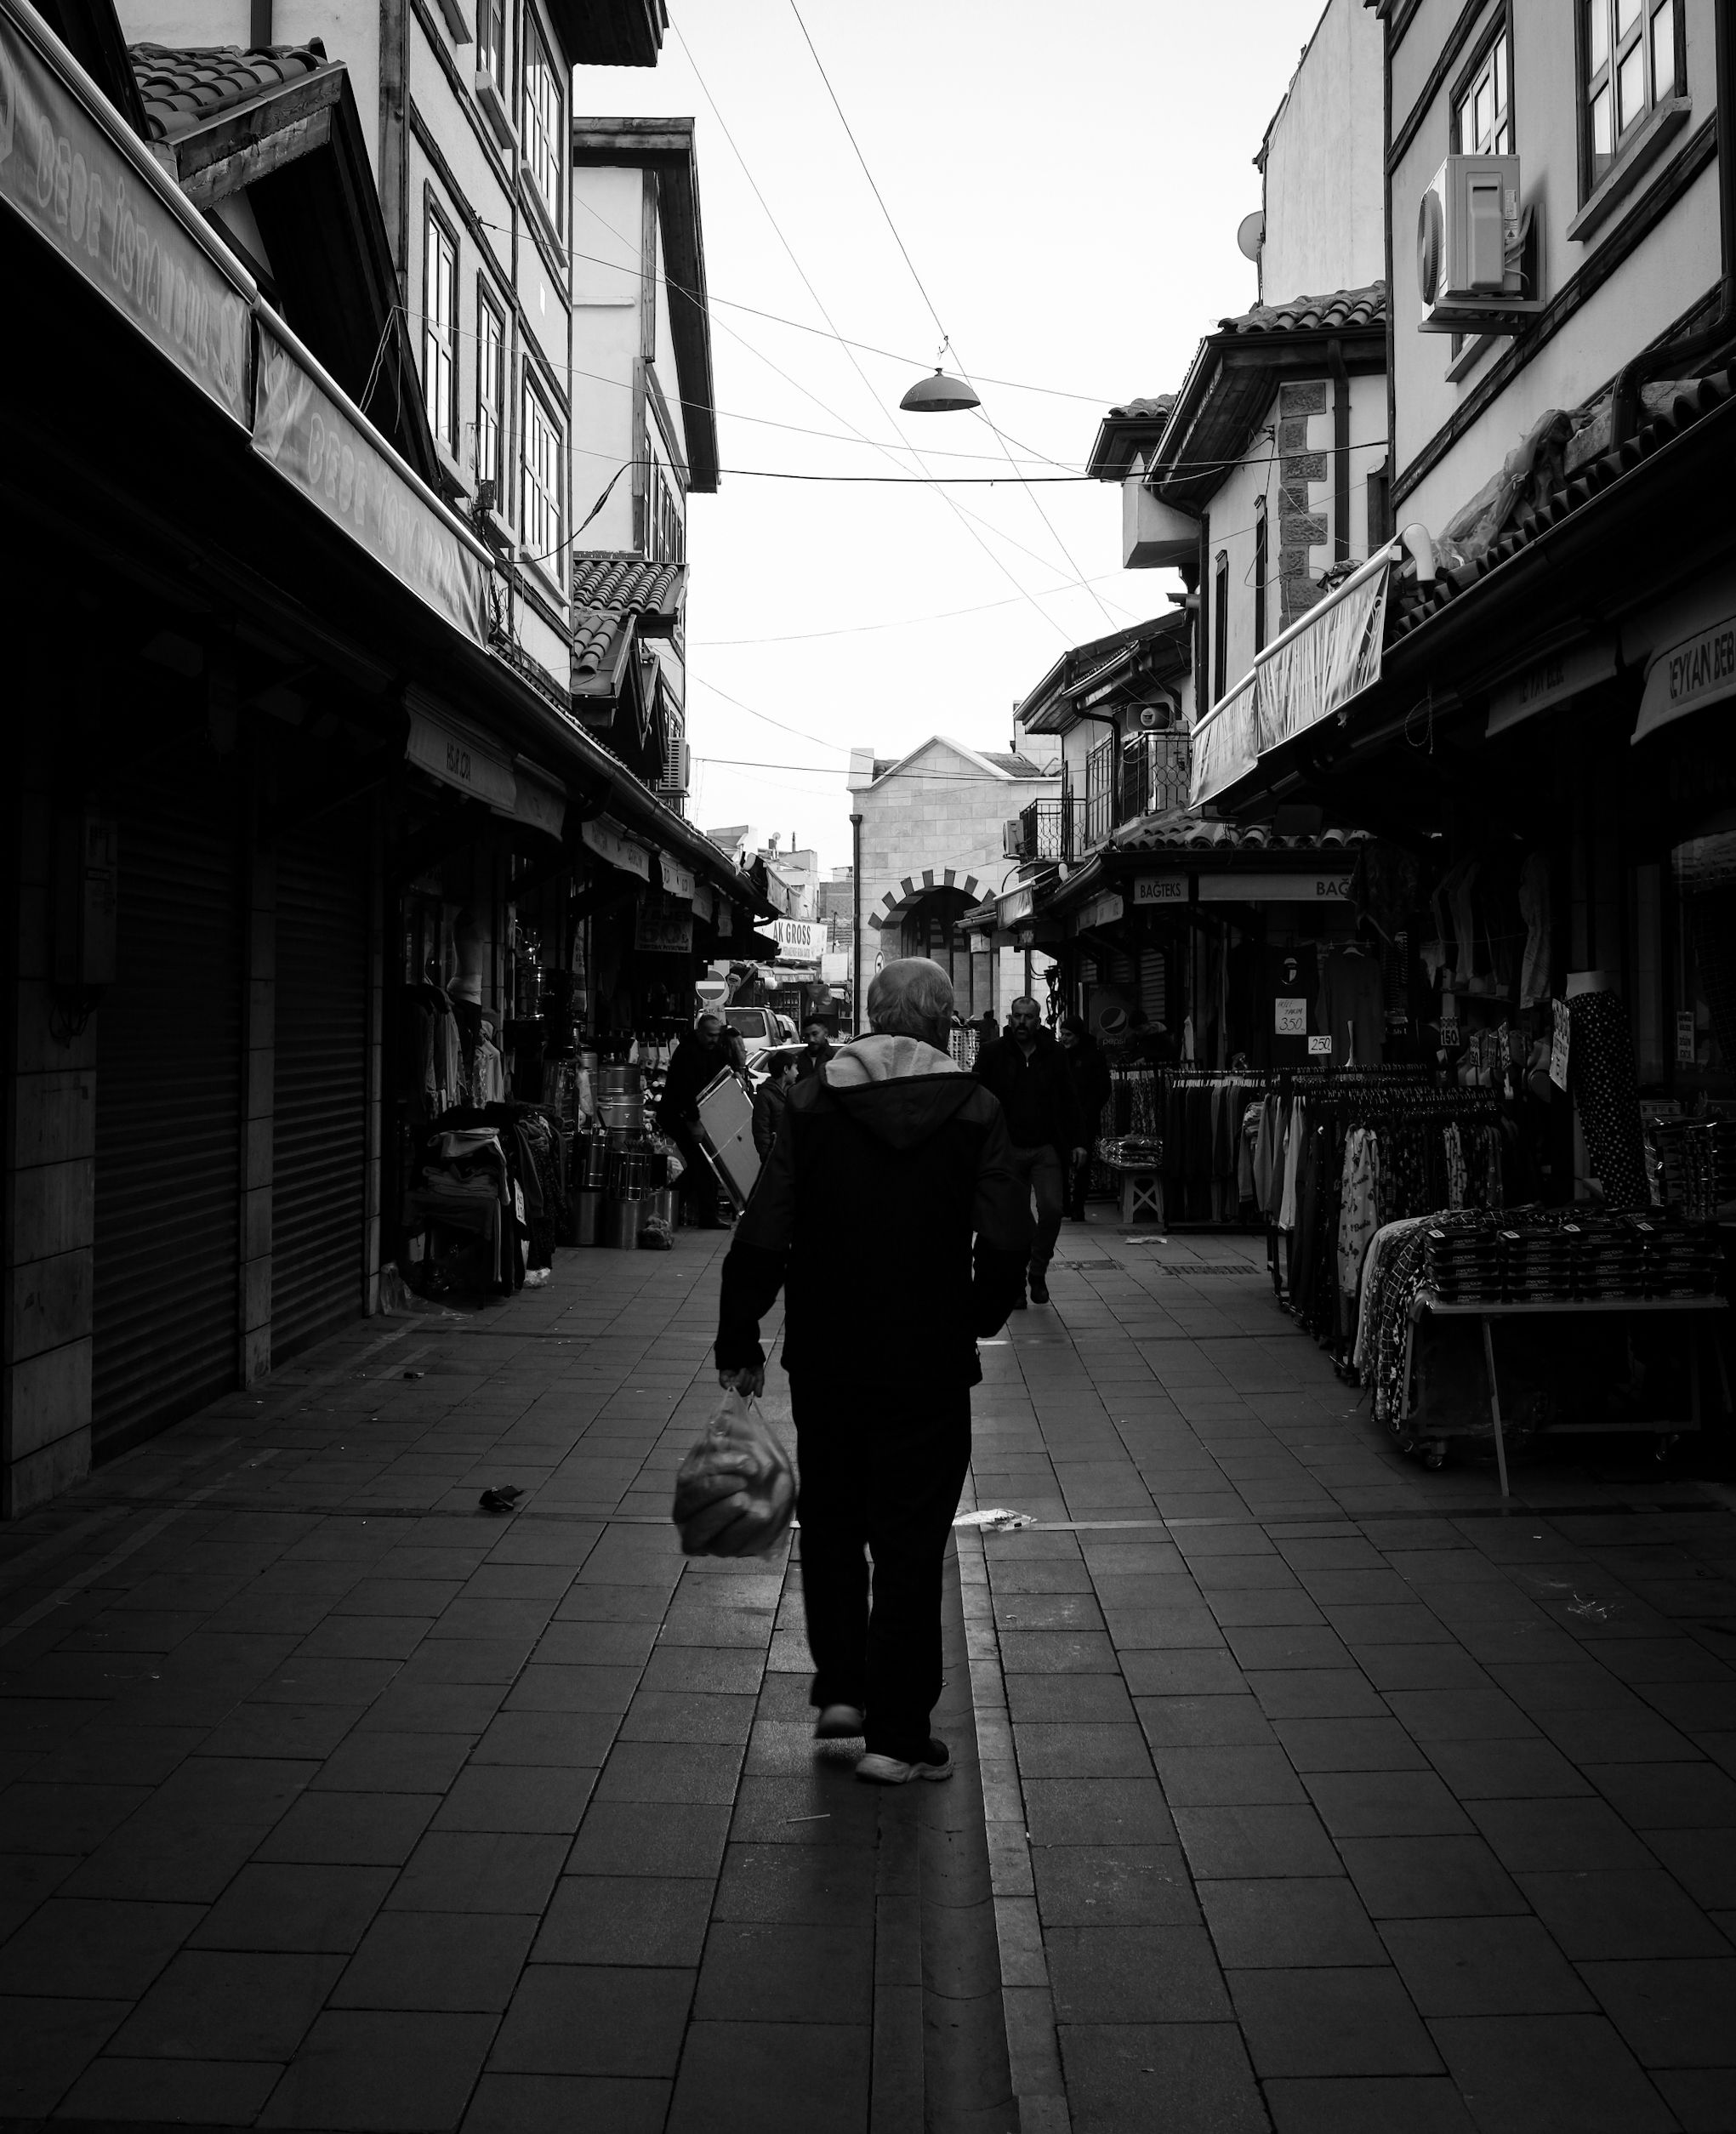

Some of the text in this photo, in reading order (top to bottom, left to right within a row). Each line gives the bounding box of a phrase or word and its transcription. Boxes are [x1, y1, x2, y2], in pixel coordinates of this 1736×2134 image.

[1140, 881, 1181, 898] BAĞTEKS
[786, 923, 811, 946] GROSS
[1442, 1029, 1457, 1044] 150
